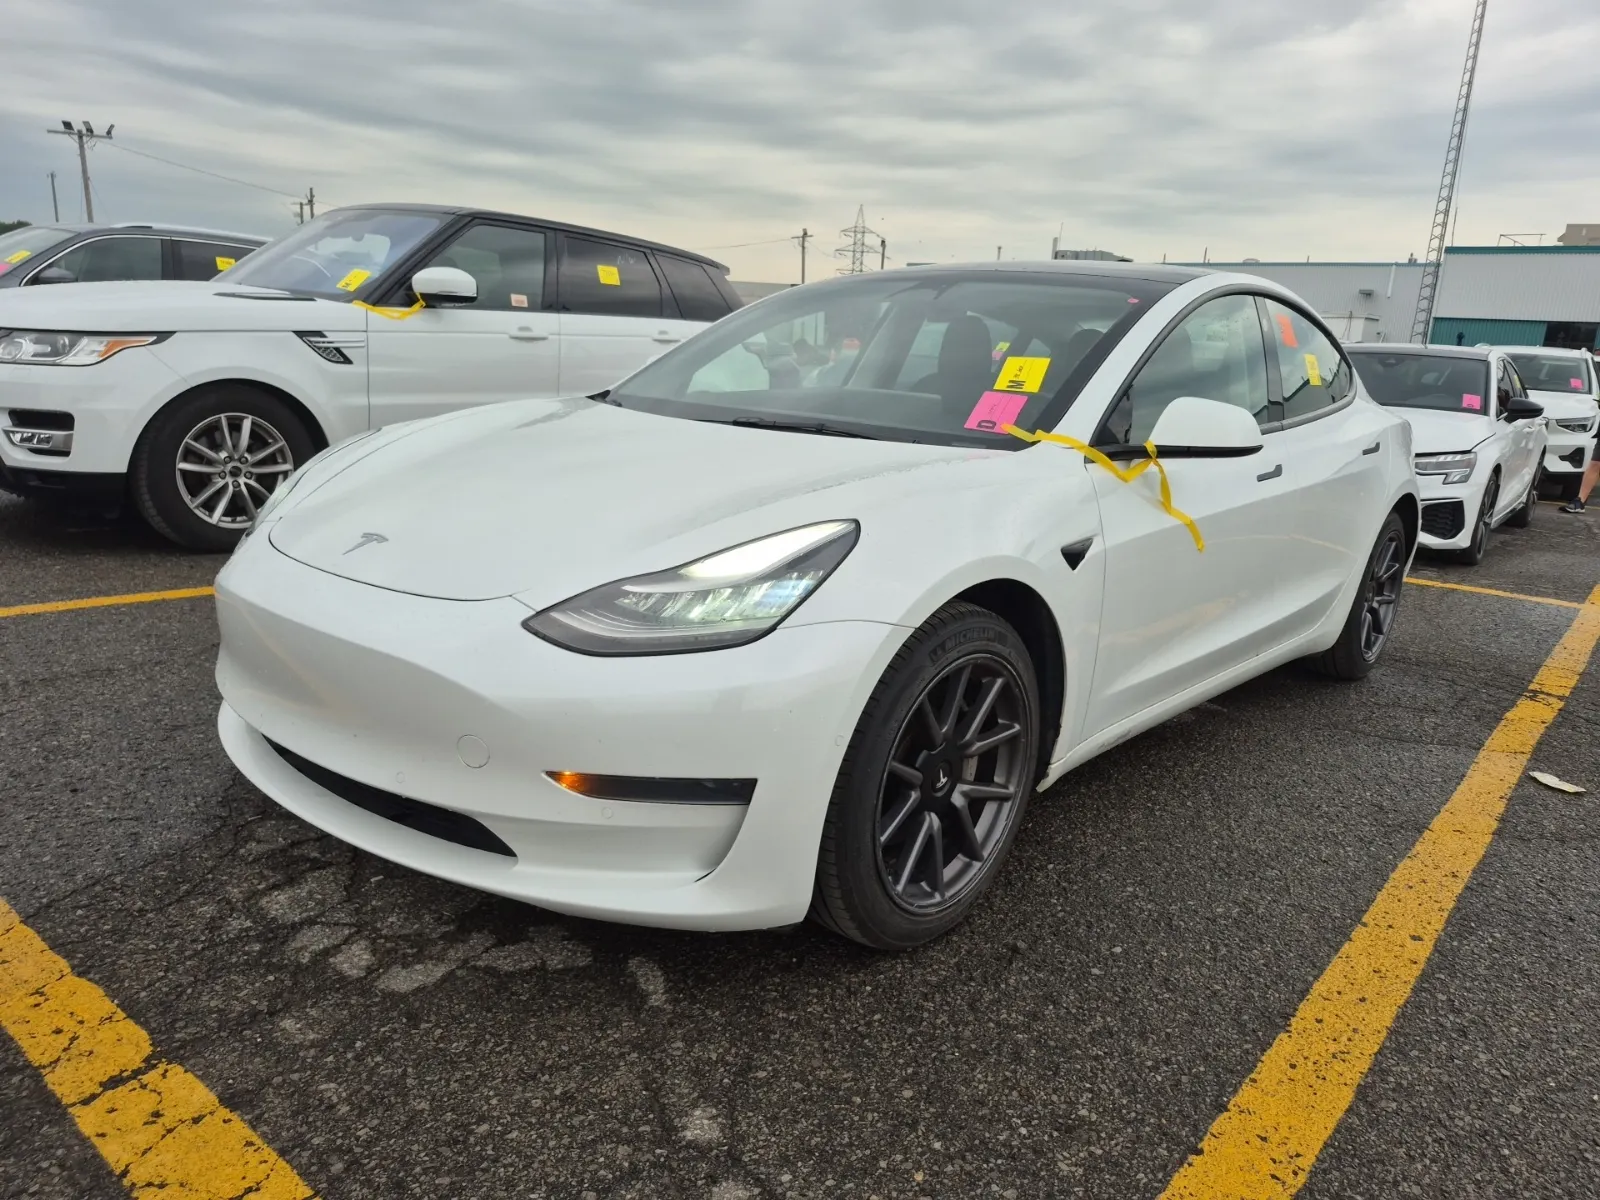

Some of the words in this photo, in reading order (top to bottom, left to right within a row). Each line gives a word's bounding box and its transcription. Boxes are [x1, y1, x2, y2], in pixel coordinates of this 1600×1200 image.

[1006, 379, 1026, 389] M
[976, 419, 997, 430] D
[945, 626, 996, 651] MICHELIN
